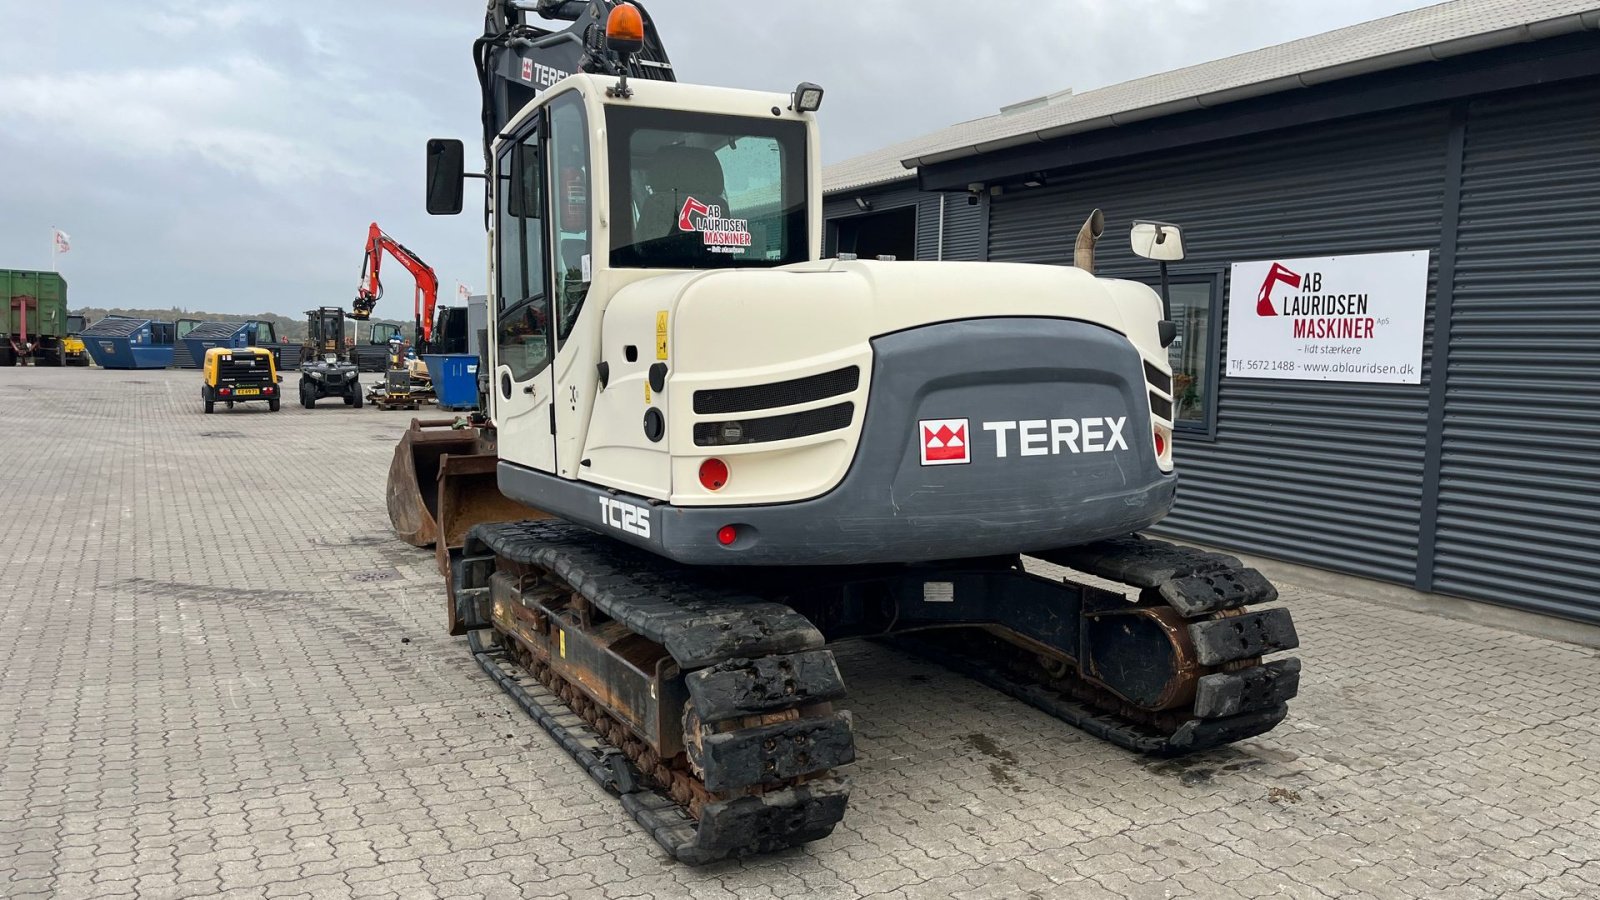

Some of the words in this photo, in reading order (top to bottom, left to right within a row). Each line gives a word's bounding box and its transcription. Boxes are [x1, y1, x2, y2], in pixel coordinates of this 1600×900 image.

[534, 62, 574, 86] TERE
[708, 205, 720, 218] AB
[697, 218, 747, 232] LAURIDSEN
[704, 231, 751, 245] MASKINER
[1302, 272, 1322, 293] AB
[1283, 293, 1368, 316] LAURIDSEN
[1293, 317, 1374, 339] MASKINER
[1377, 317, 1390, 326] ApS
[1304, 344, 1318, 354] lidt
[1320, 344, 1362, 355] stærkere
[1231, 359, 1245, 372] Tlf.
[1247, 360, 1270, 371] 5672
[1272, 361, 1295, 371] 1488
[1303, 362, 1414, 376] www.ablauridsen.dk
[983, 416, 1129, 458] TEREX
[599, 495, 651, 539] TC125
